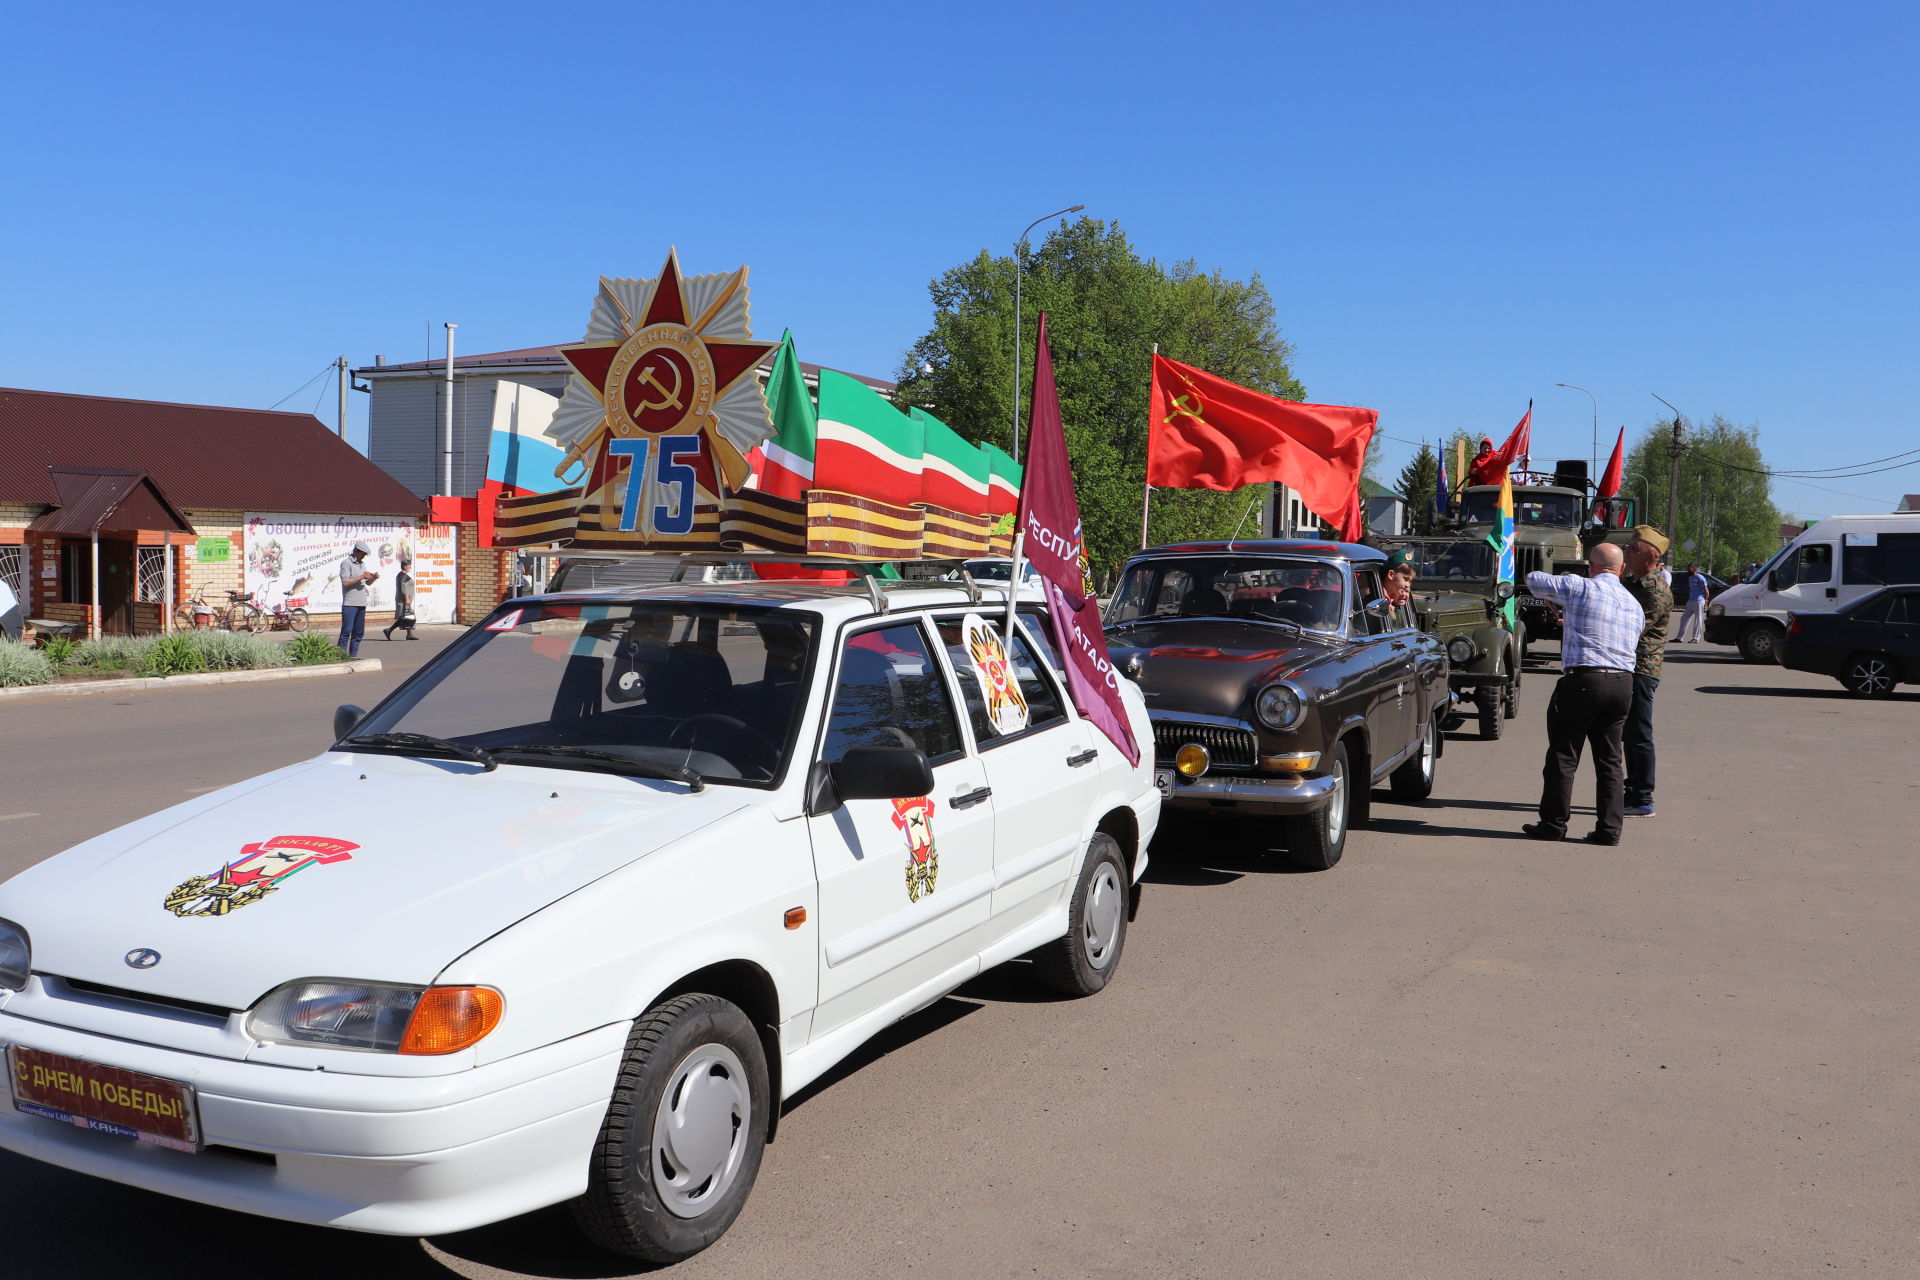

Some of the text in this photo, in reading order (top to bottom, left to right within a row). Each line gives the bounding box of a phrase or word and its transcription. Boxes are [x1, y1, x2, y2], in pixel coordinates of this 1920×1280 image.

[610, 329, 689, 435] ОТЕЧЕСТВЕННАЯ
[609, 434, 701, 535] 75
[265, 516, 395, 539] овощи и фрукты
[419, 525, 450, 538] ОПТОМ
[297, 549, 333, 566] свежая
[1073, 622, 1119, 692] АТАРС
[17, 1061, 184, 1119] С ДНЕМ ПОБЕДЫ!
[55, 1111, 74, 1124] LADA
